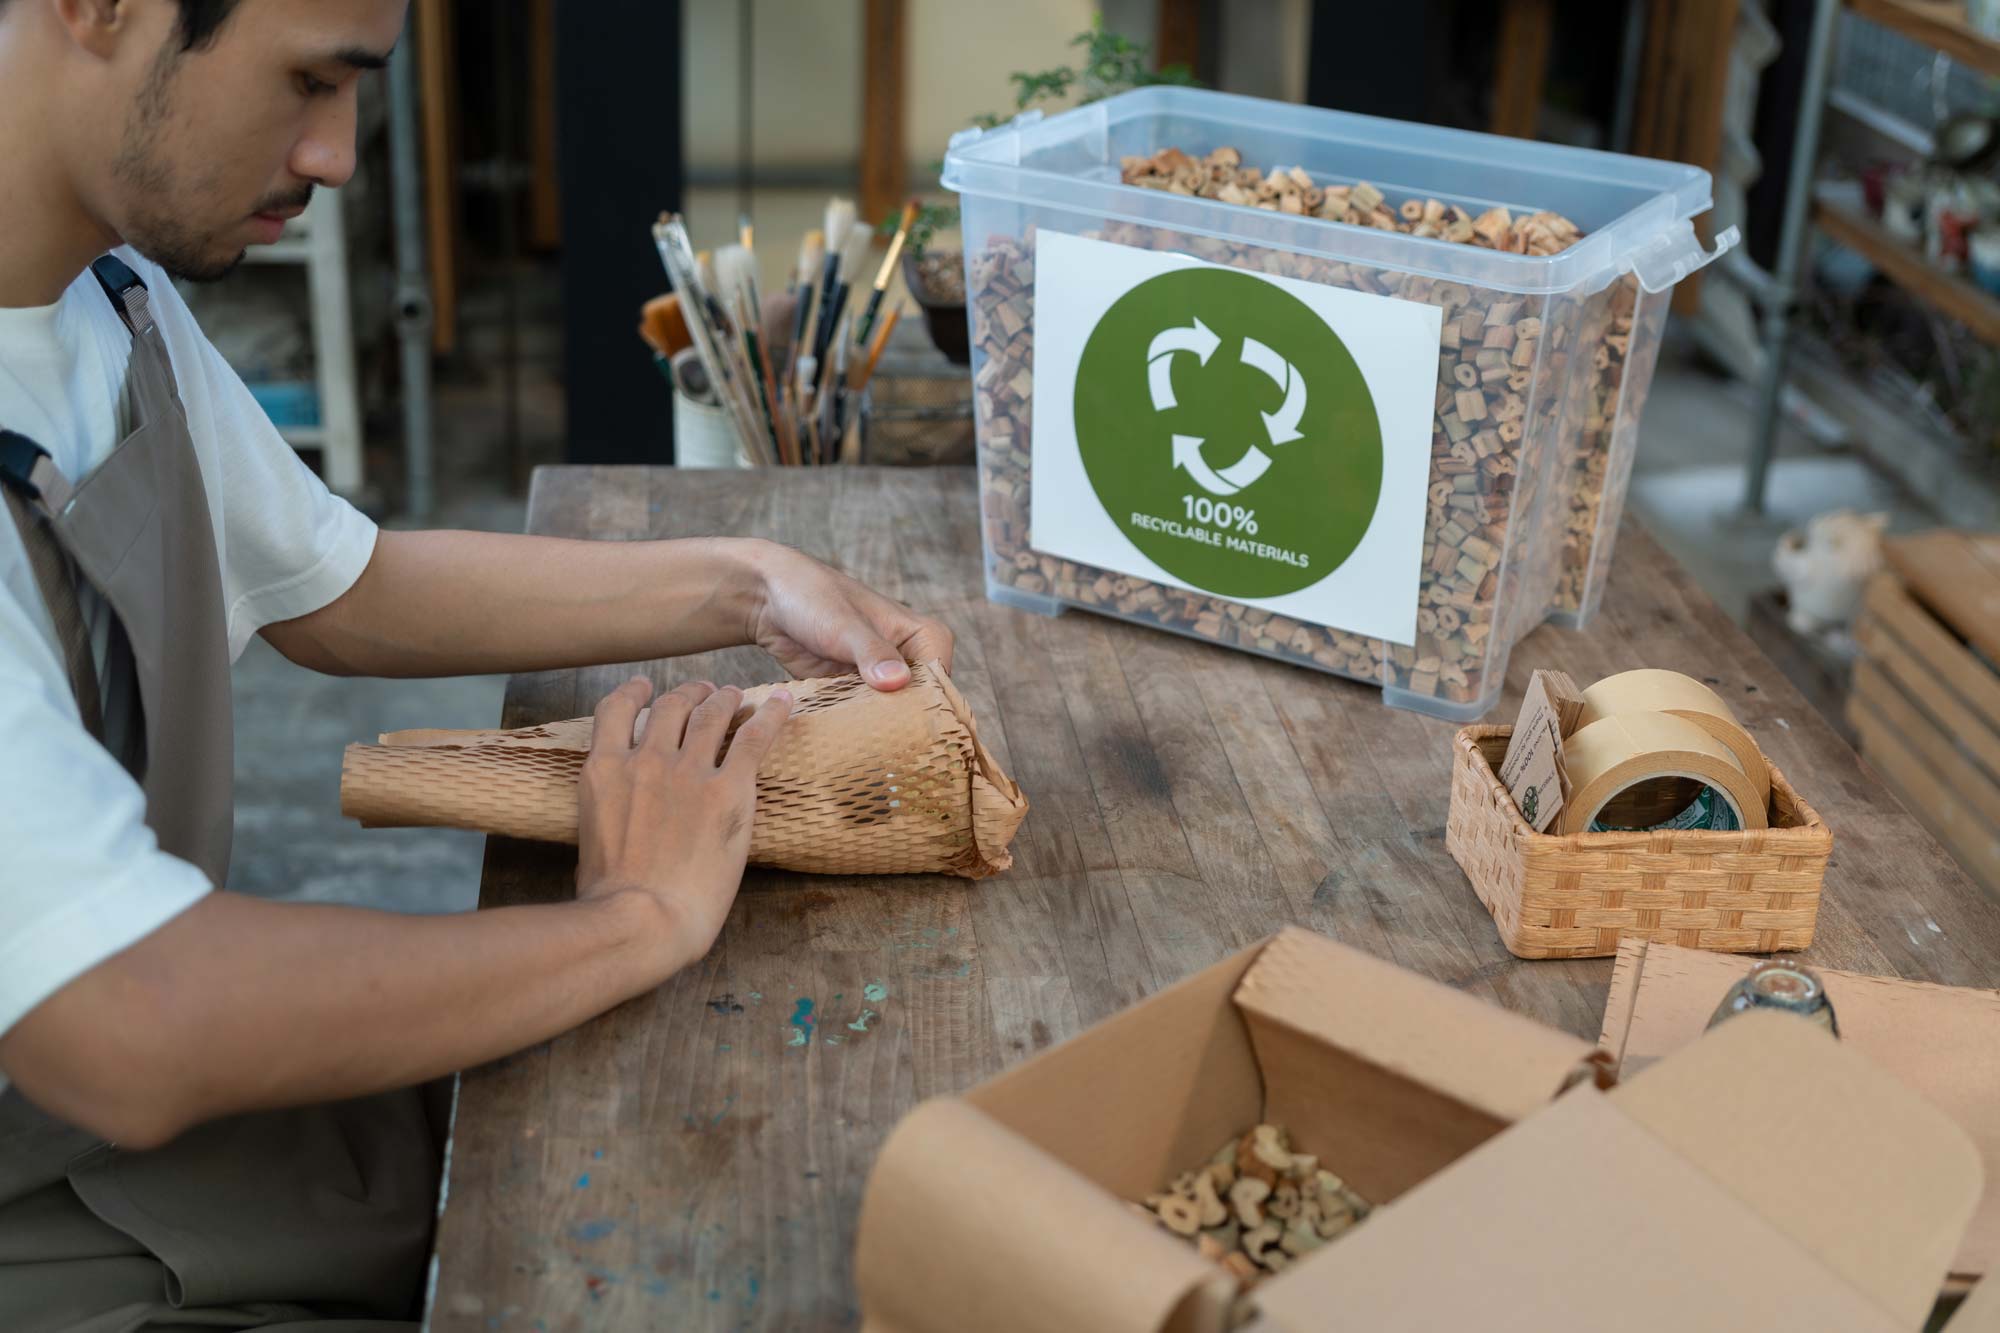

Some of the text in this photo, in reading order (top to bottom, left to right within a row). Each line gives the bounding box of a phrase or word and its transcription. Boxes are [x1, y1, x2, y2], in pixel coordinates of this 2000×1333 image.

[1131, 511, 1309, 568] RECYCLABLE MATERIALS
[1182, 494, 1259, 536] 100%
